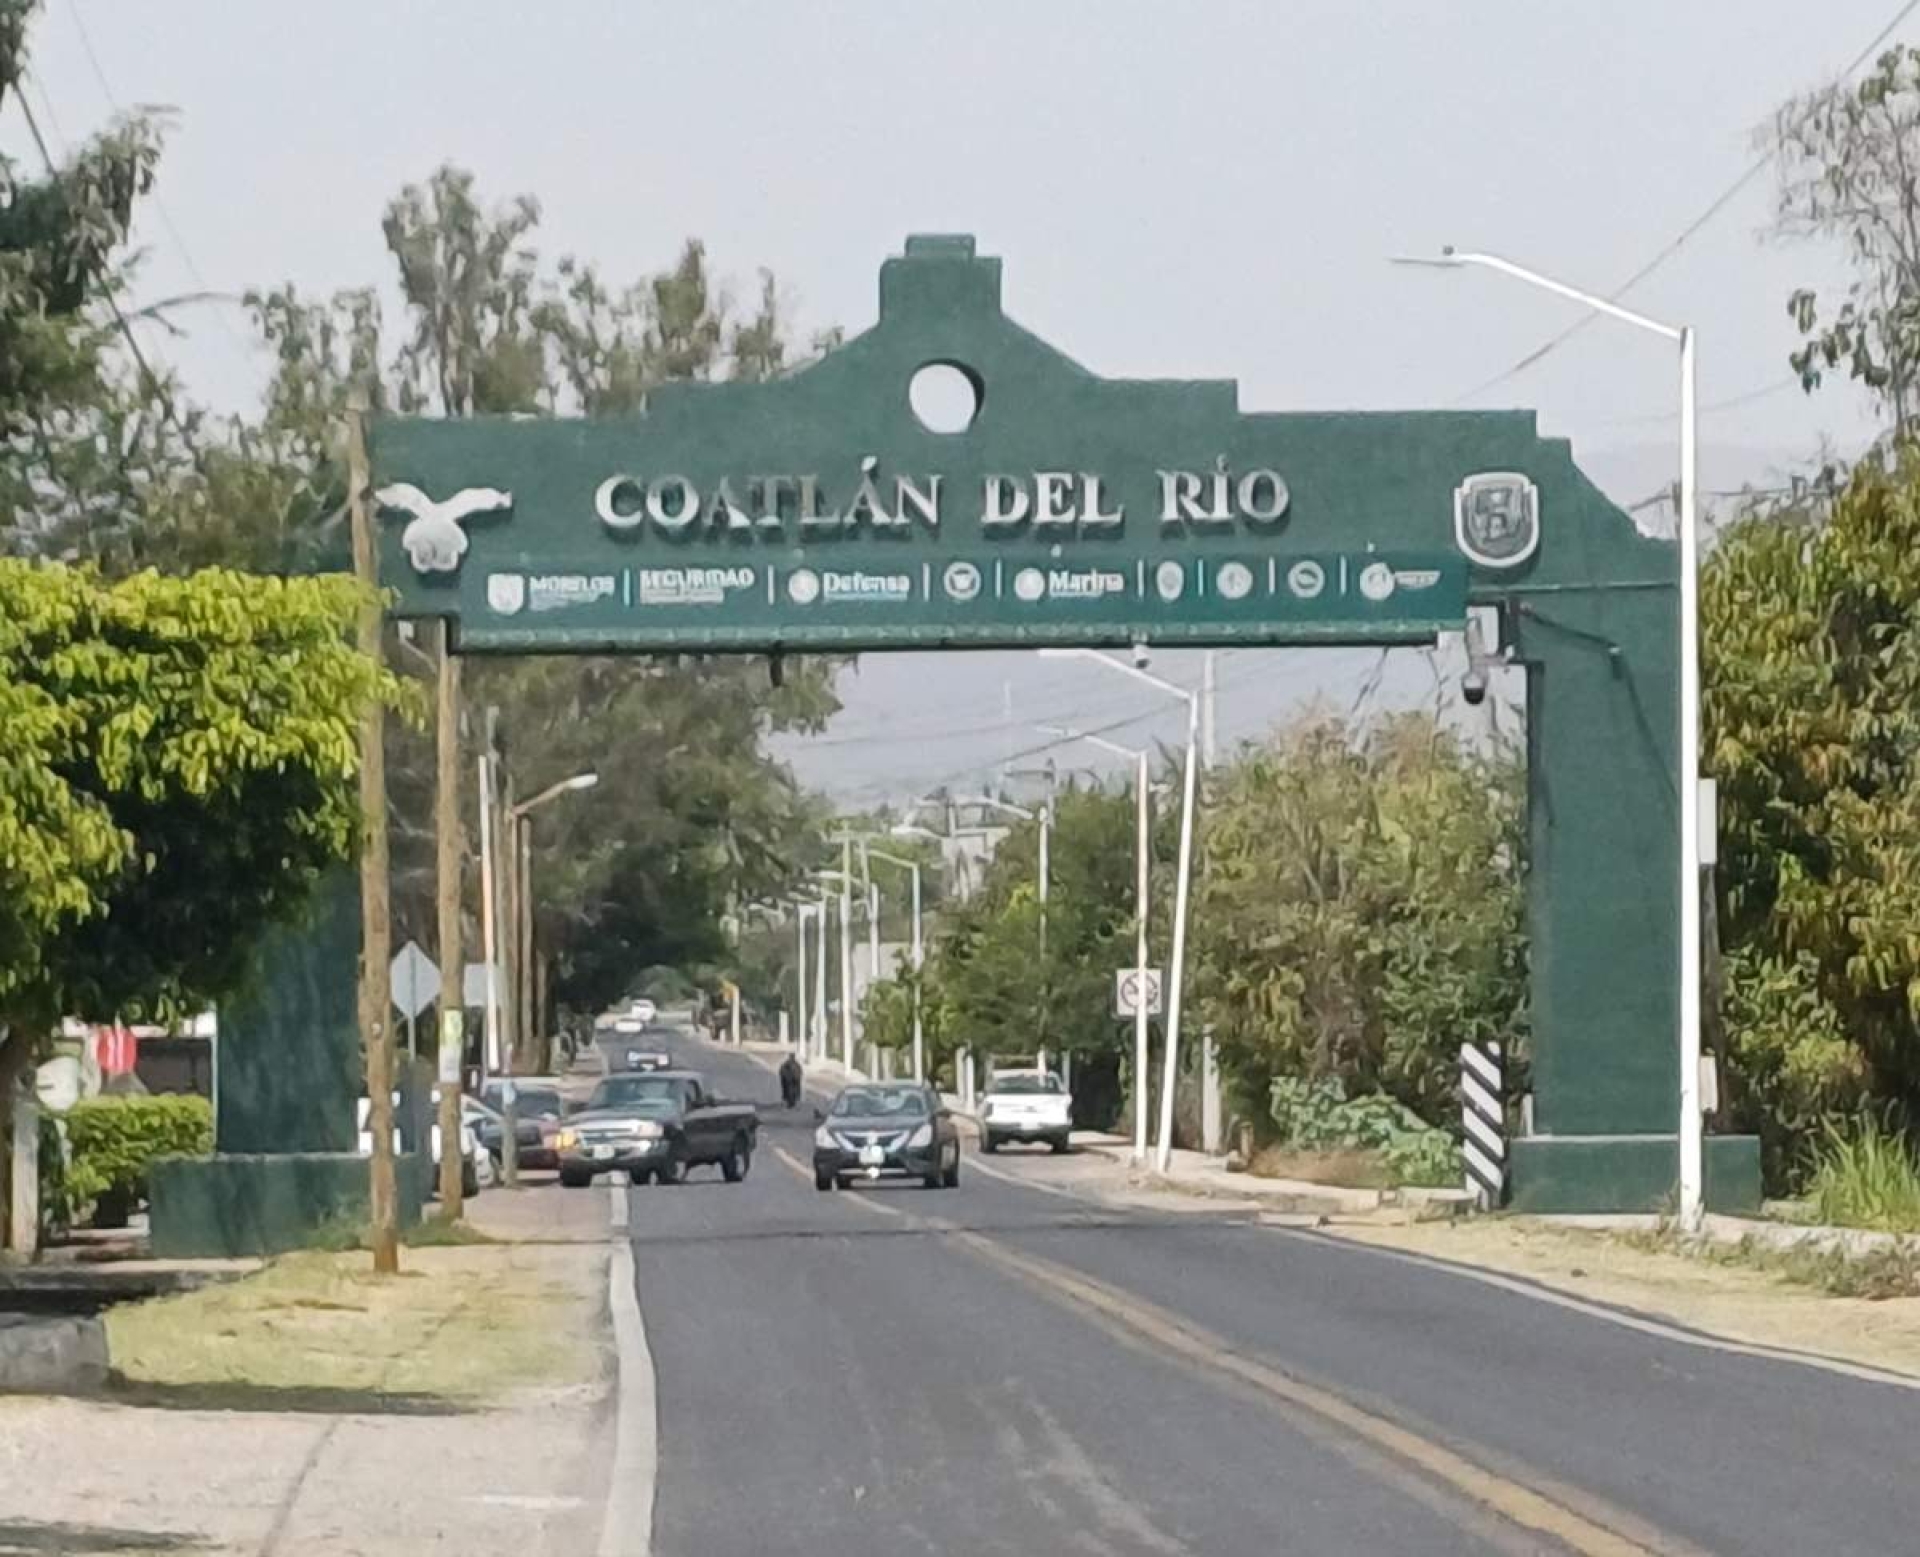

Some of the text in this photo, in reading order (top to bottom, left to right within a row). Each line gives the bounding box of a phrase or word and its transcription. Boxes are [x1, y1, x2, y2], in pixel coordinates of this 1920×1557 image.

[595, 453, 1289, 528] COATLÁN DEL RÍO
[823, 572, 910, 593] Defensa
[1049, 570, 1124, 593] Marina
